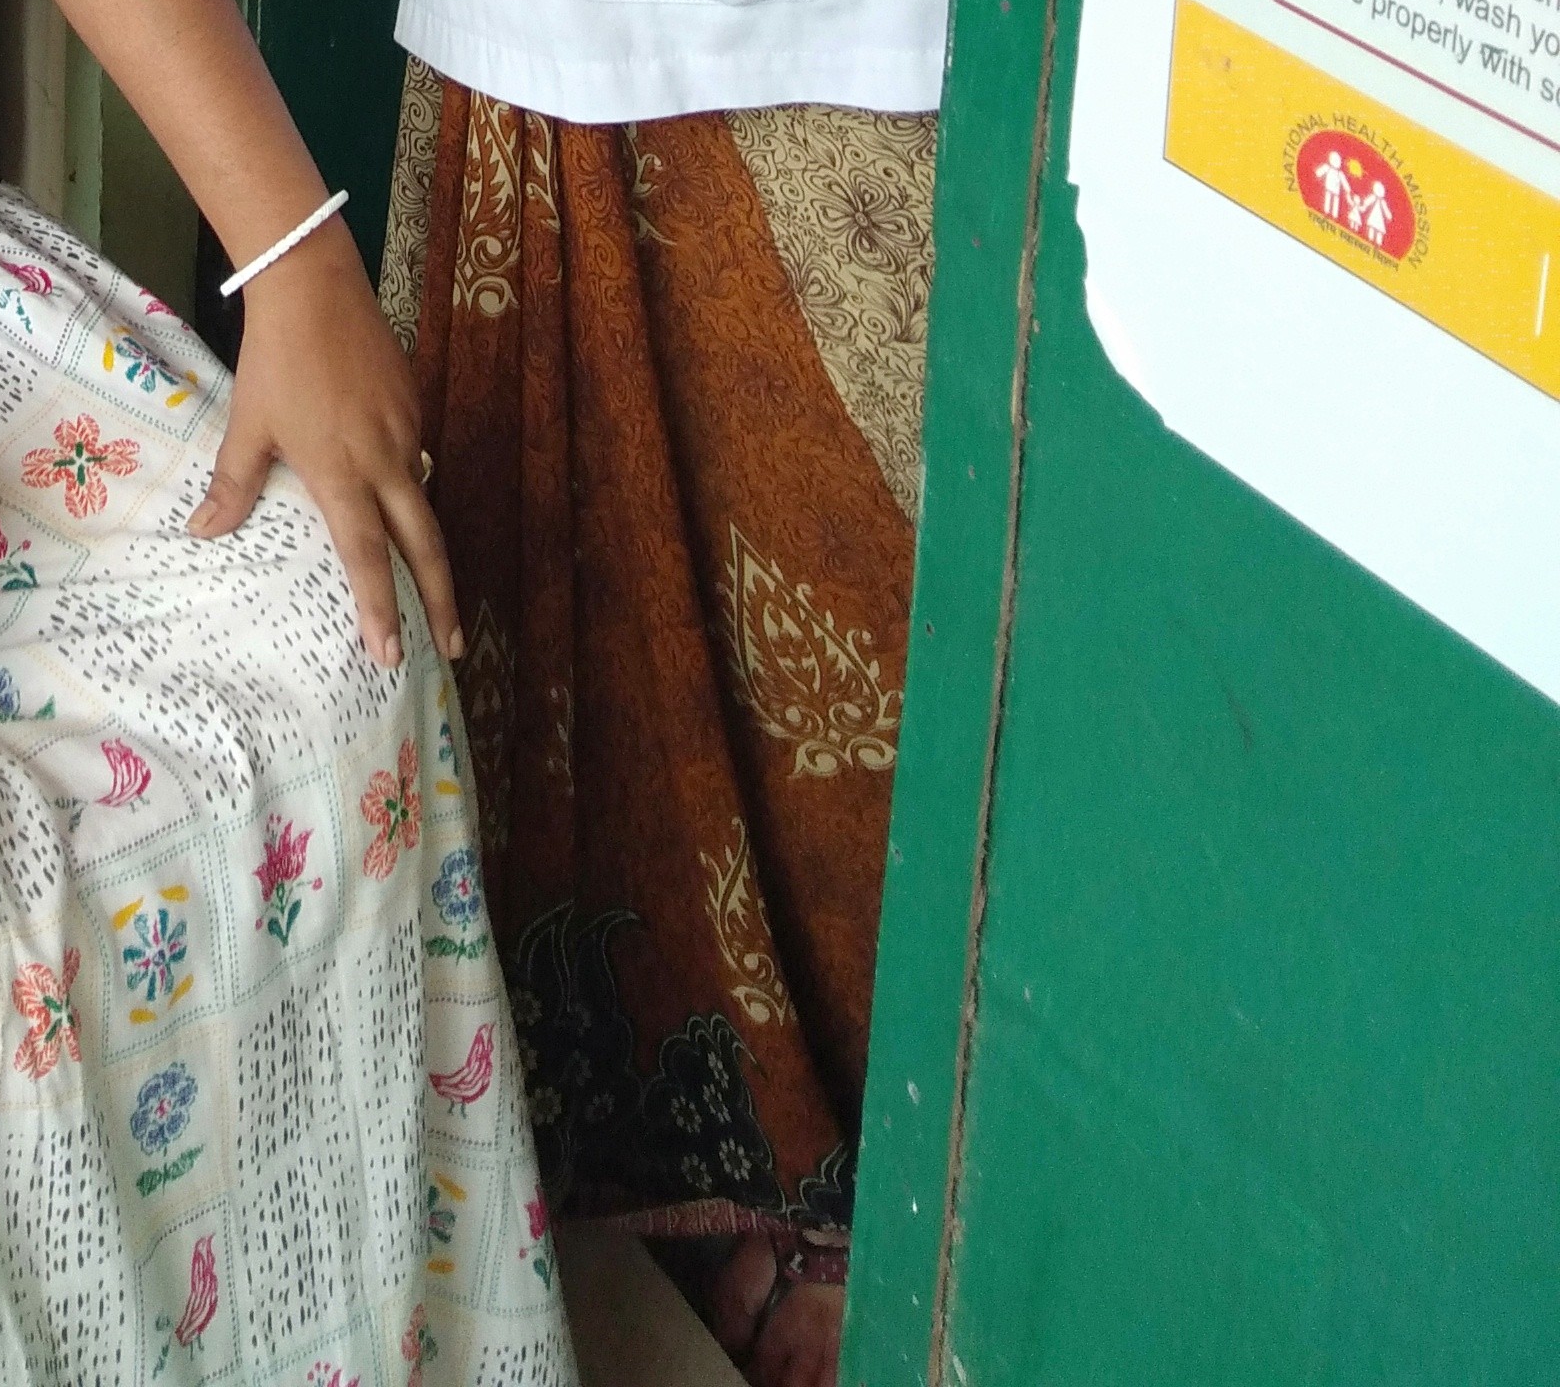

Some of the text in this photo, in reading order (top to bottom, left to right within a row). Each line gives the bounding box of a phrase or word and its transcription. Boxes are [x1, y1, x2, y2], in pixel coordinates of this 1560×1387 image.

[1482, 42, 1532, 91] with
[1283, 113, 1329, 193] NATIONAL
[1332, 112, 1404, 169] HEALTH
[1403, 173, 1430, 270] MISSION
